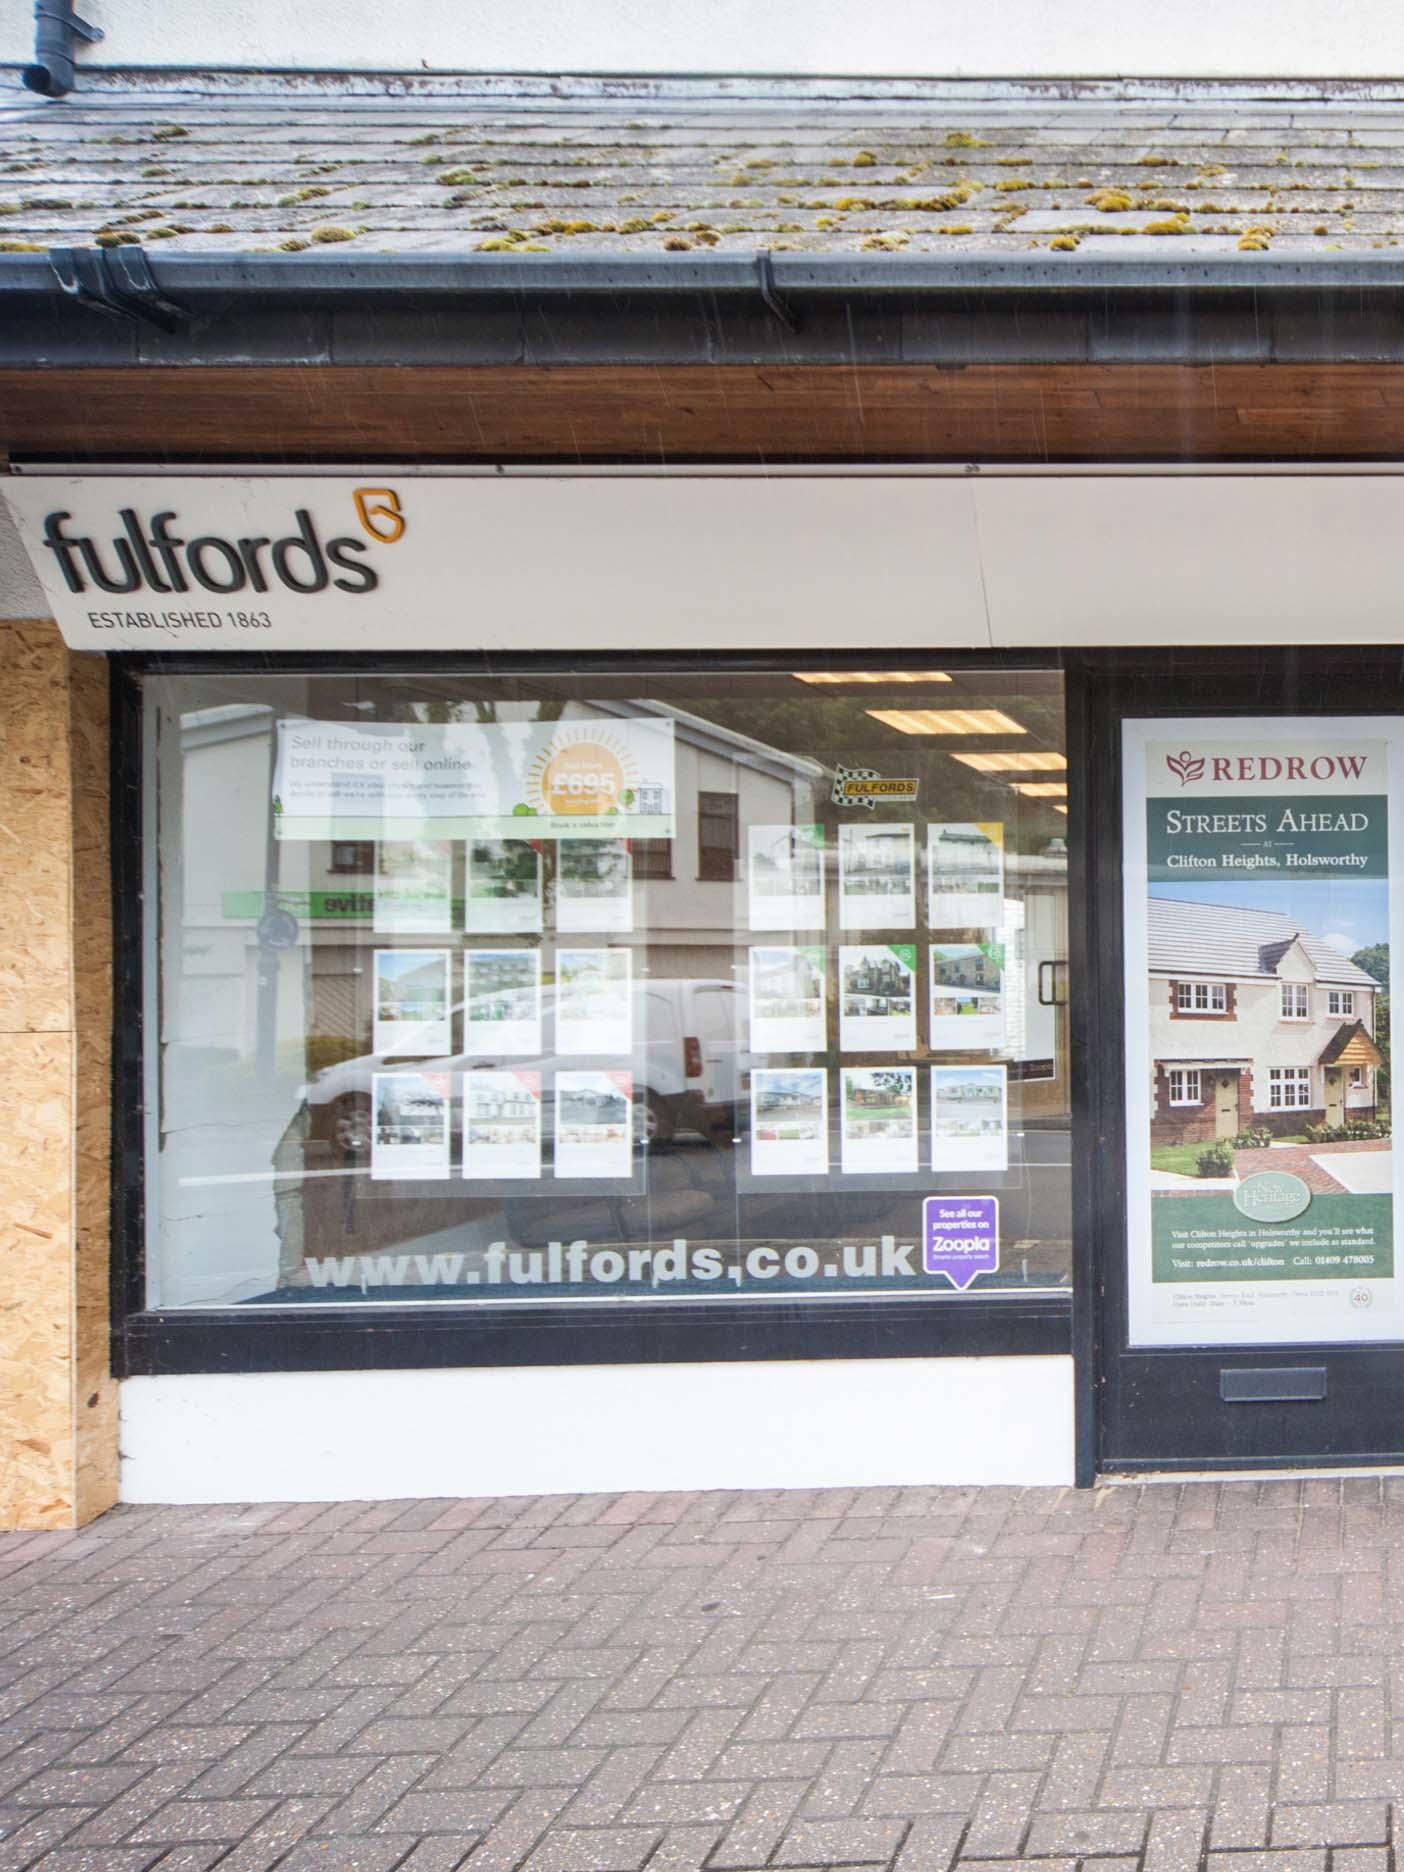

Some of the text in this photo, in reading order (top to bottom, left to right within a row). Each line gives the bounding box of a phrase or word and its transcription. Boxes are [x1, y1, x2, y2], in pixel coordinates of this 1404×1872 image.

[43, 508, 380, 594] fulfords
[87, 611, 273, 630] ESTABLISHED 1863
[1211, 755, 1368, 782] REDROW
[550, 773, 616, 795] £695
[847, 782, 914, 793] FULFORDS
[1166, 808, 1369, 834] STREETS AHEAD
[1166, 852, 1369, 870] Clifton Heights, Holsworthy
[938, 1208, 983, 1219] See all our
[932, 1220, 990, 1231] properties on
[932, 1235, 990, 1254] Zoopla
[304, 1235, 918, 1287] www.fulfords.co.uk
